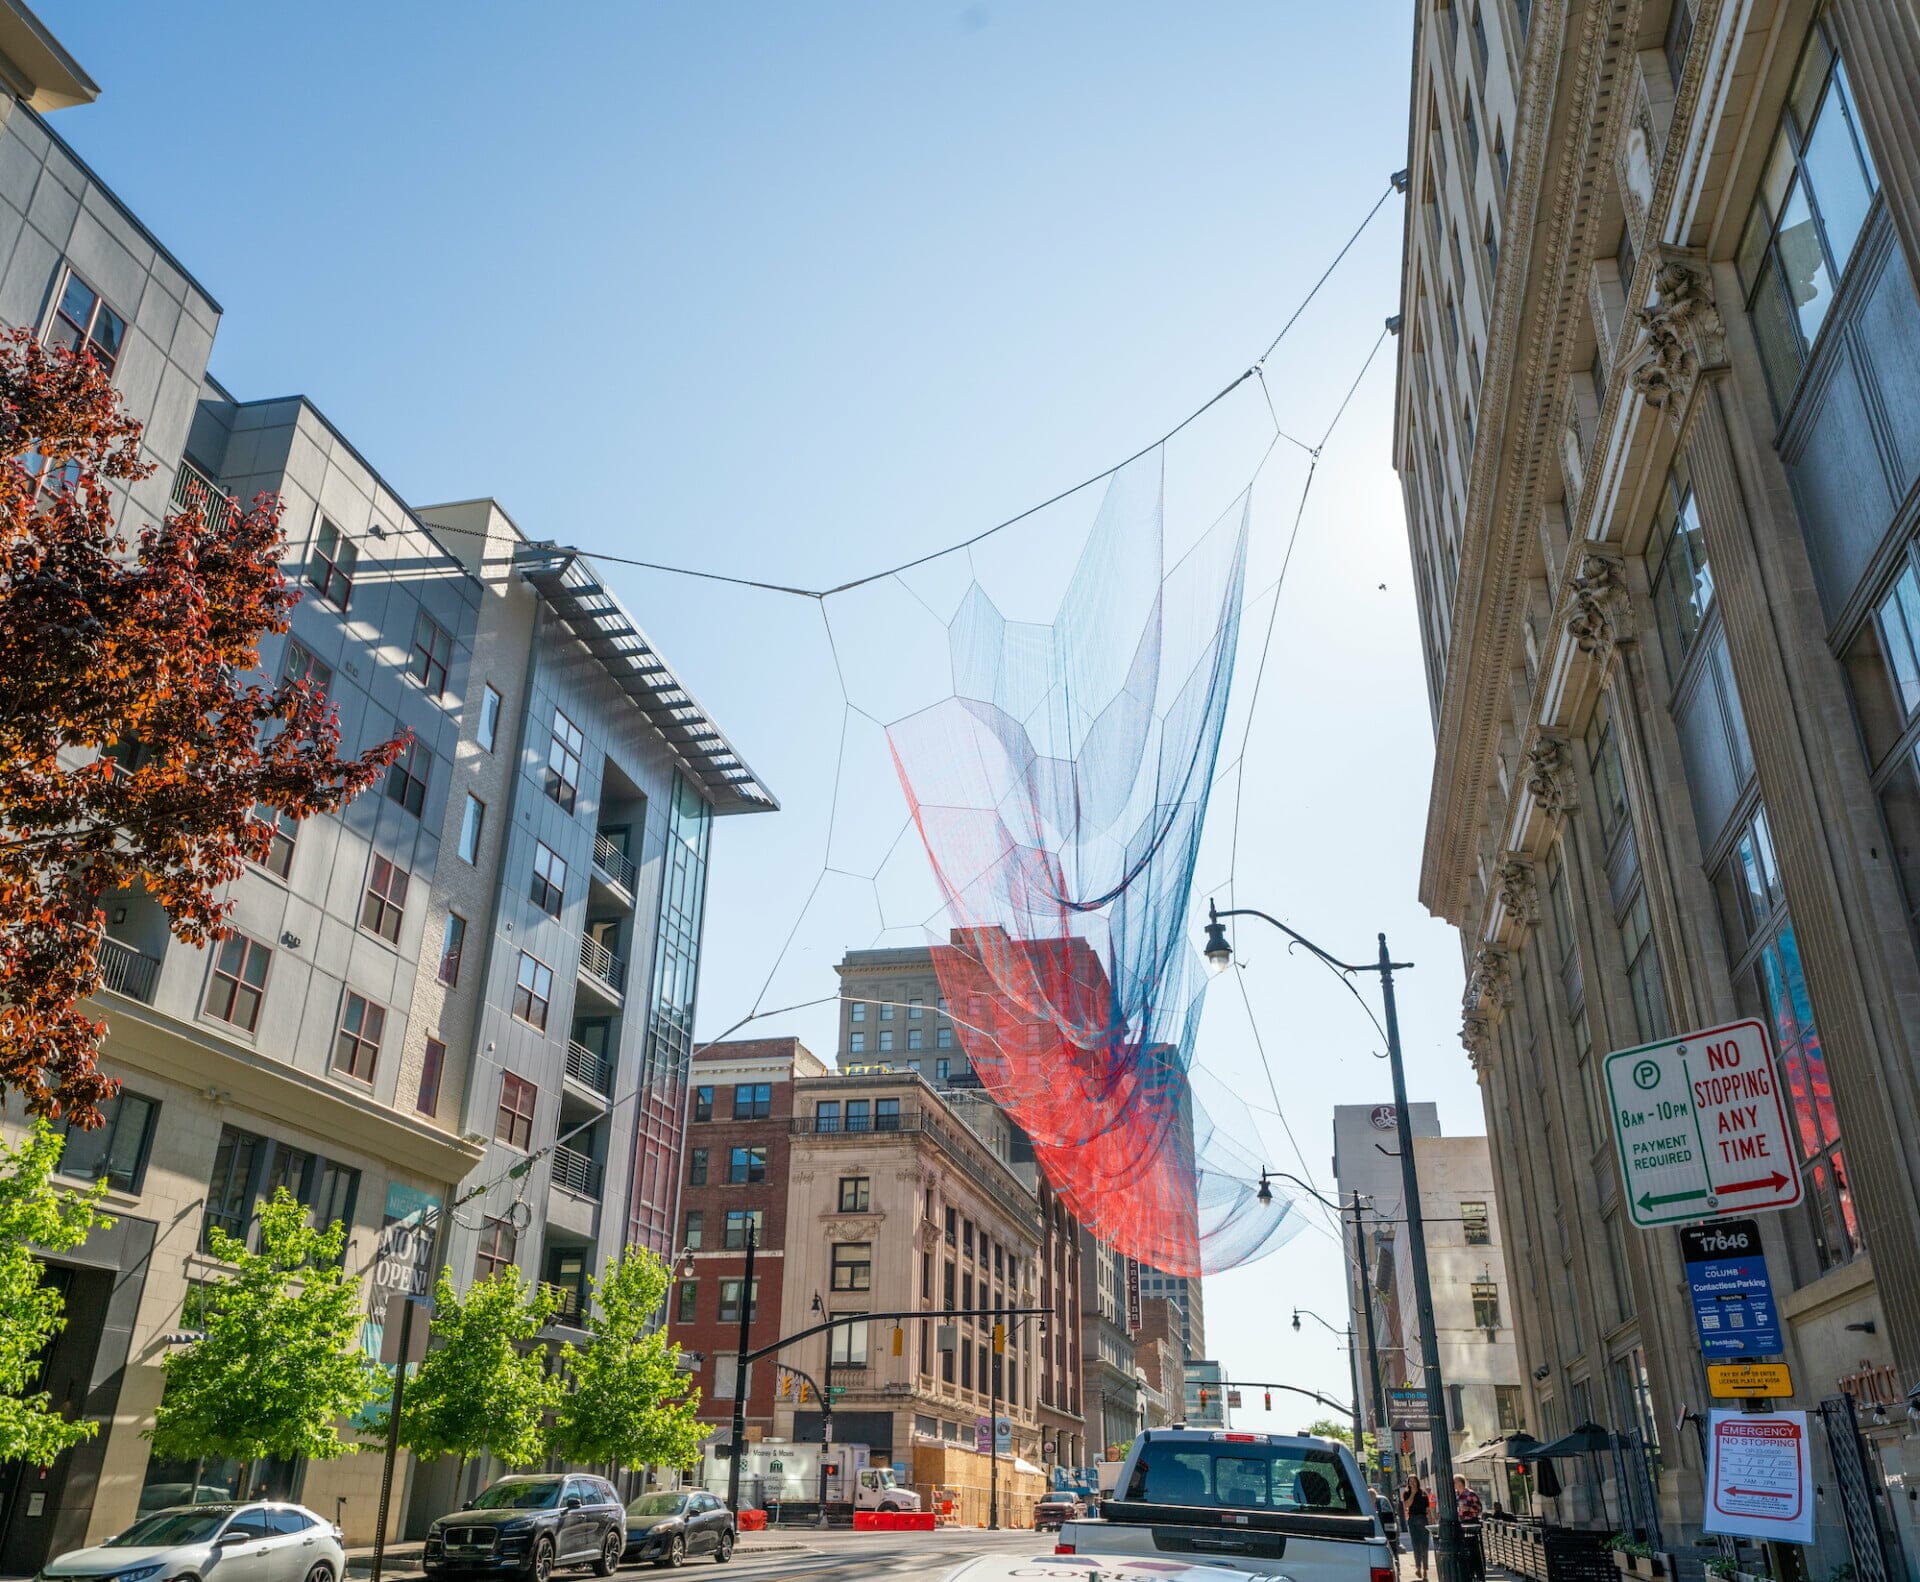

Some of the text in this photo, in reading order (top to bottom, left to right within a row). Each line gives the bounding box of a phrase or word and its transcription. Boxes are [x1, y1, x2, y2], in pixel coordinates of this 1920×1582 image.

[1706, 1039, 1741, 1072] NO
[1694, 1068, 1769, 1108] STOPPING
[1621, 1110, 1645, 1129] 8AM
[1656, 1101, 1689, 1121] 10PM
[1718, 1105, 1758, 1134] ANY
[1632, 1134, 1687, 1155] PAYMENT
[1719, 1134, 1770, 1163] TIME
[1634, 1150, 1692, 1170] REQUIRED
[380, 1226, 432, 1265] NOW
[1700, 1233, 1749, 1252] 17646
[377, 1260, 428, 1295] OPEN!
[1693, 1279, 1766, 1292] Contactless Parking
[1721, 1426, 1794, 1436] EMERGENCY
[1722, 1437, 1795, 1448] NO STOPPING
